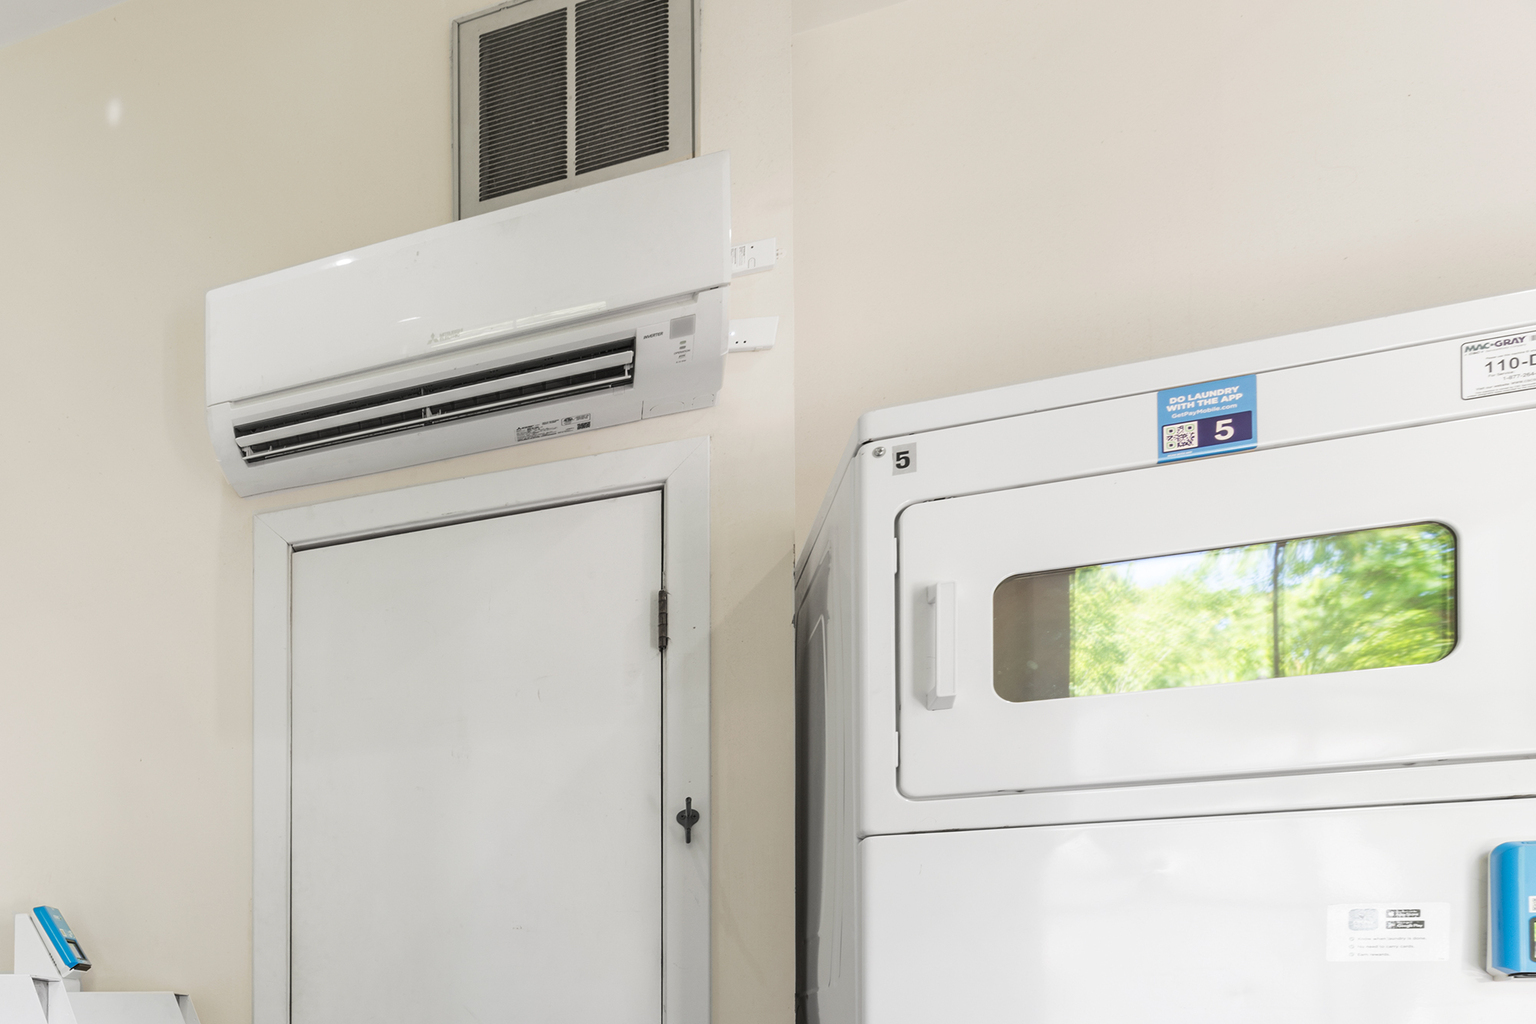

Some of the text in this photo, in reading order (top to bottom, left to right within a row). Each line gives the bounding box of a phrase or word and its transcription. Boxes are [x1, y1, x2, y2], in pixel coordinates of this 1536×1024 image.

[643, 332, 664, 340] INVERTER
[1465, 336, 1526, 352] MAC-GRAY
[1166, 393, 1243, 412] WITH THE APP
[1169, 386, 1239, 404] DO LAUNDRY
[1171, 403, 1237, 418] GetPayMobile.com
[1214, 419, 1234, 440] 5
[895, 450, 911, 470] 5
